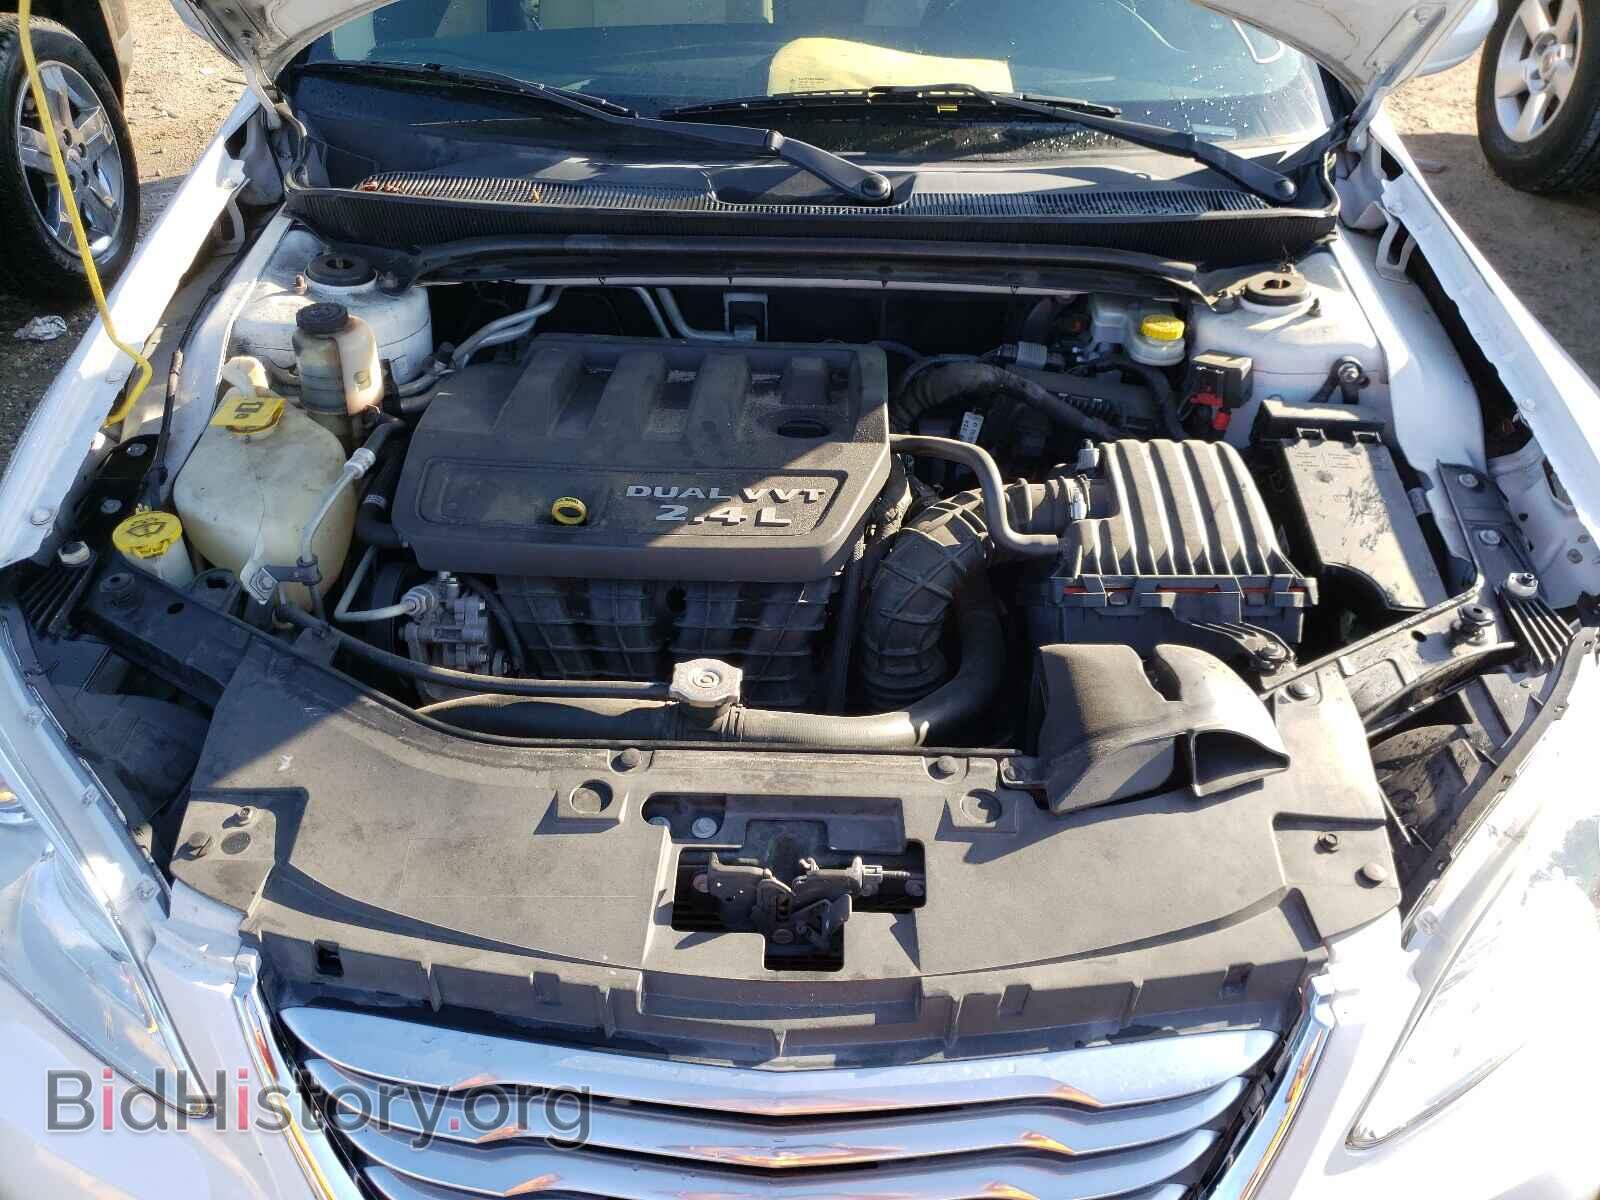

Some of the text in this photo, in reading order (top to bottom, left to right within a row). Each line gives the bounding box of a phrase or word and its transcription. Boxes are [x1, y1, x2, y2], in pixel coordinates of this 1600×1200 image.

[626, 485, 826, 503] DUAL VVT
[655, 504, 792, 527] 2.4L
